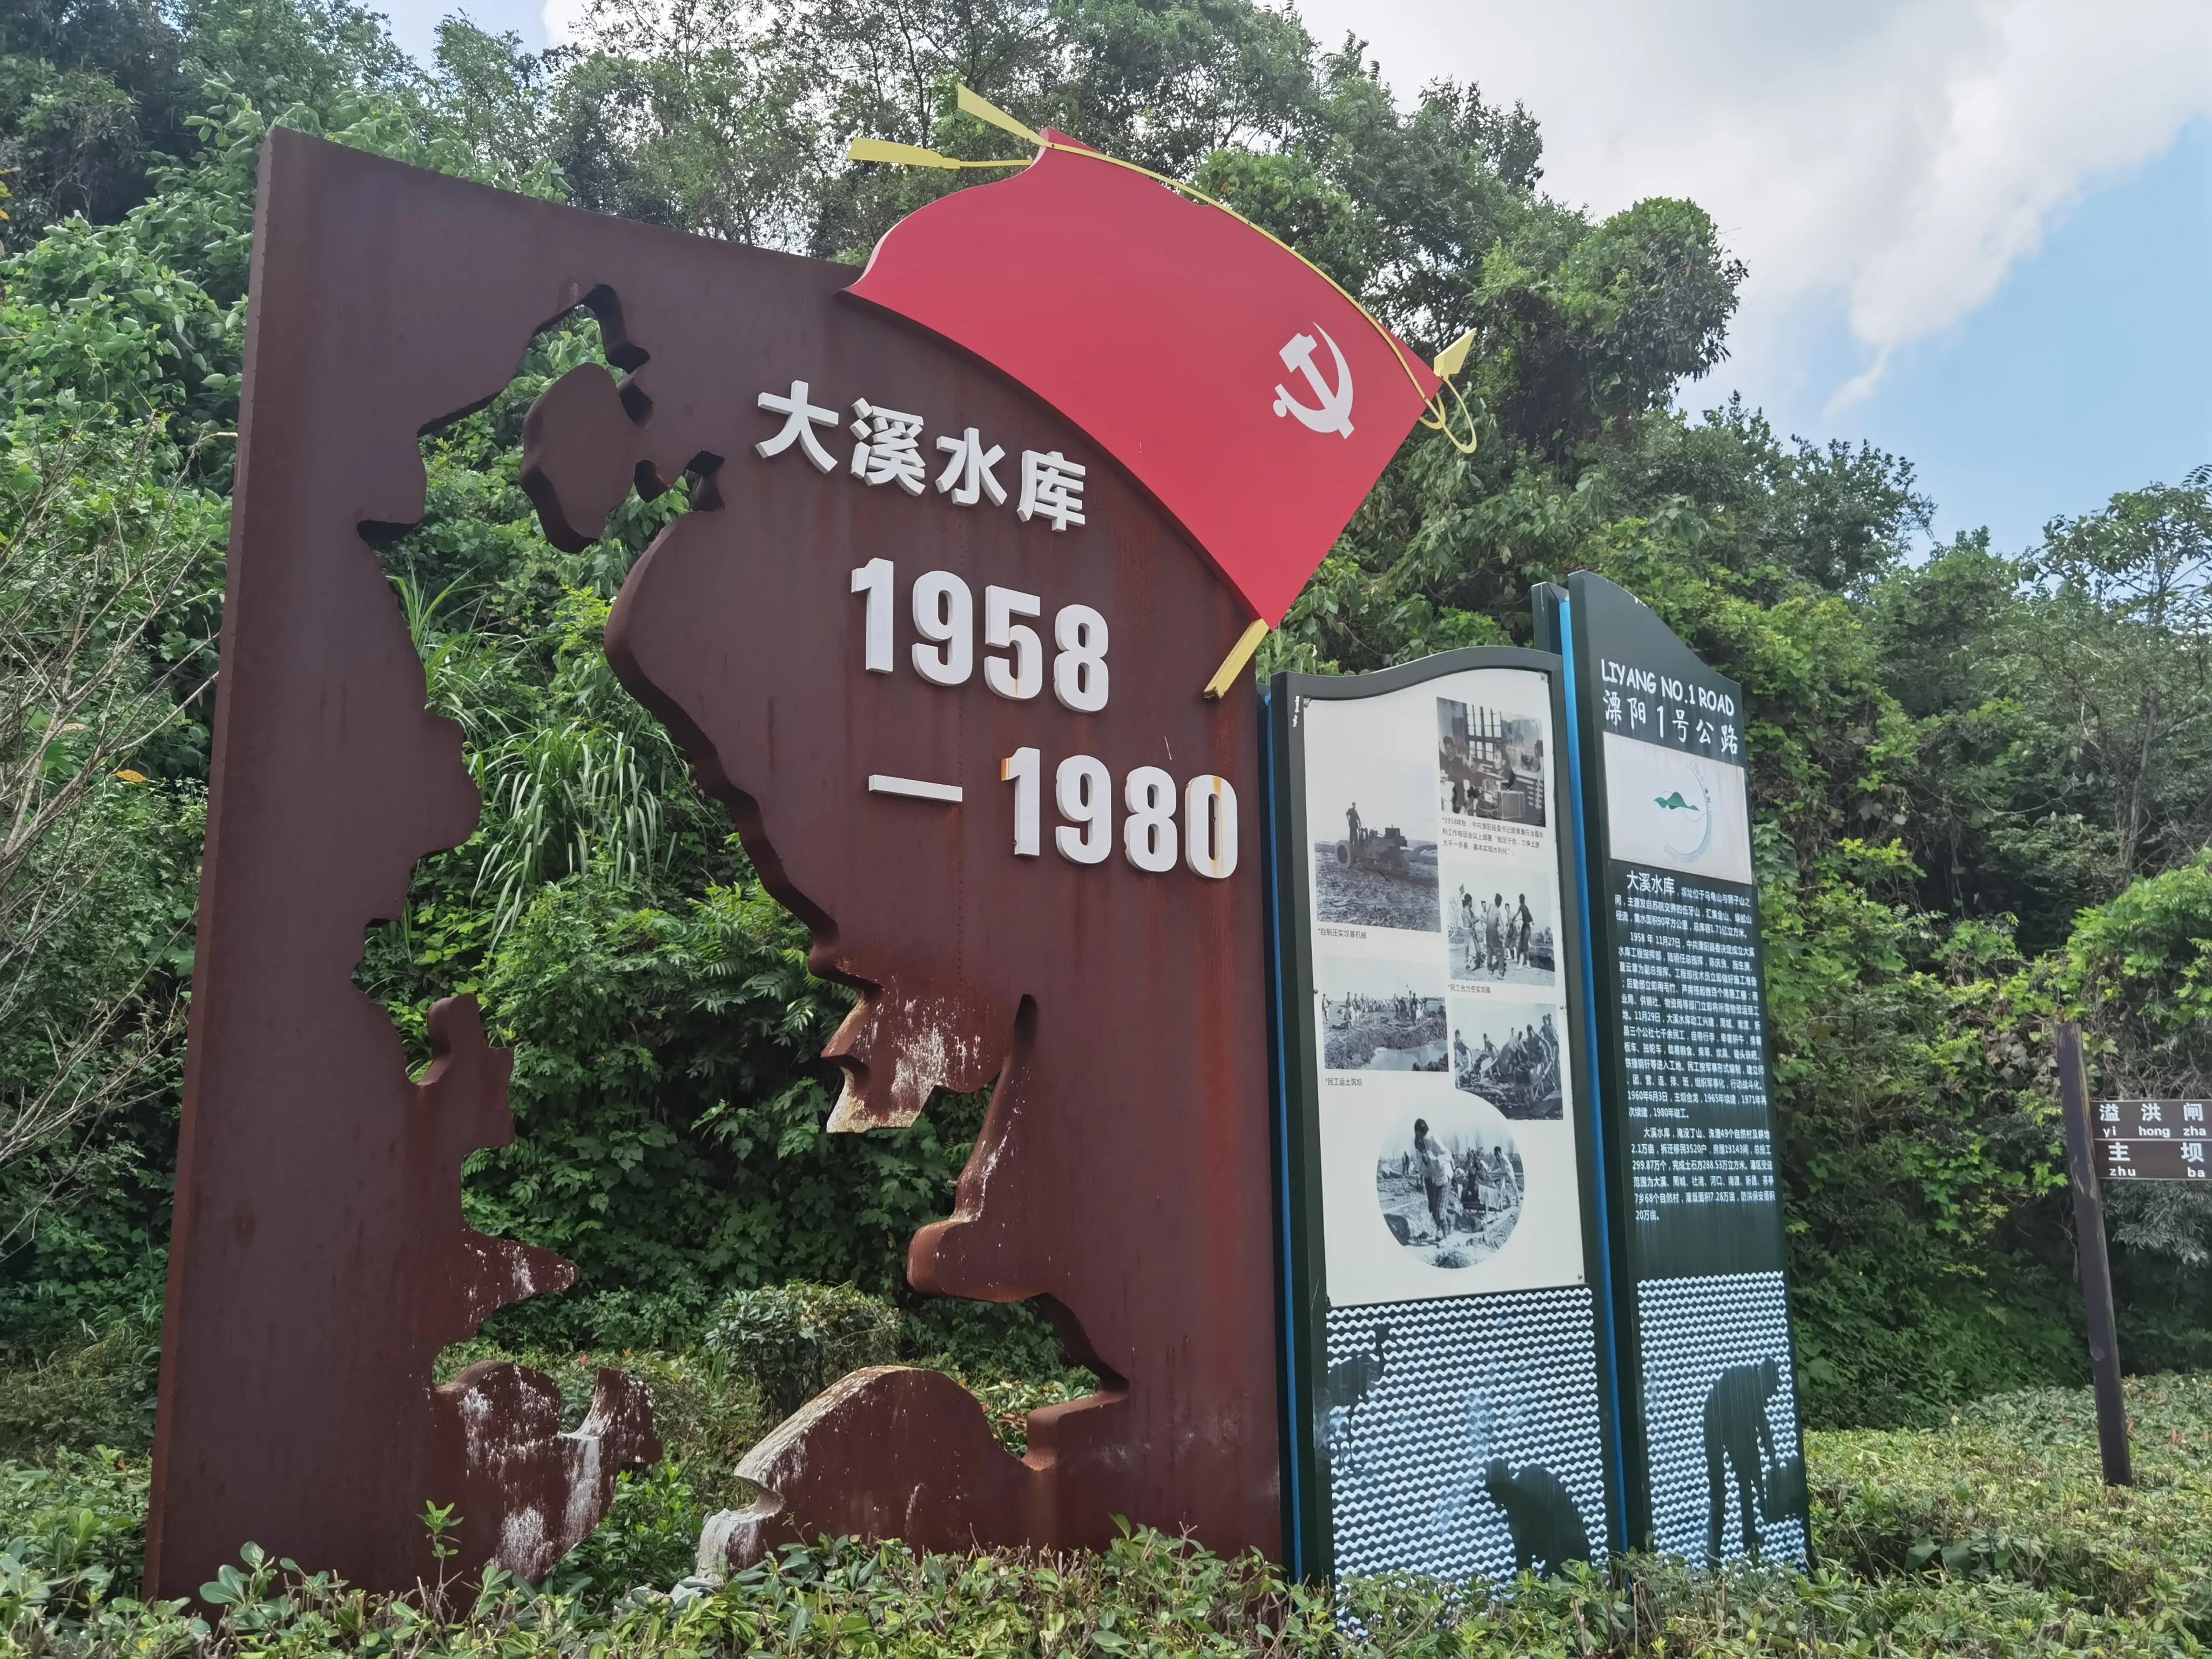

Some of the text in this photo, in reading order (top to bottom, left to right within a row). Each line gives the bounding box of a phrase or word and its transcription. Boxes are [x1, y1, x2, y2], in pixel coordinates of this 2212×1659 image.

[756, 380, 1085, 532] 大溪水库
[851, 557, 1109, 712] 1958
[1601, 658, 1735, 716] LIYANG NO.1 ROAD
[1603, 690, 1737, 754] 溧阳1号公路
[1630, 932, 1645, 942] 1958
[2102, 1125, 2206, 1138] yi hong zha
[2109, 1166, 2205, 1177] zhu ba
